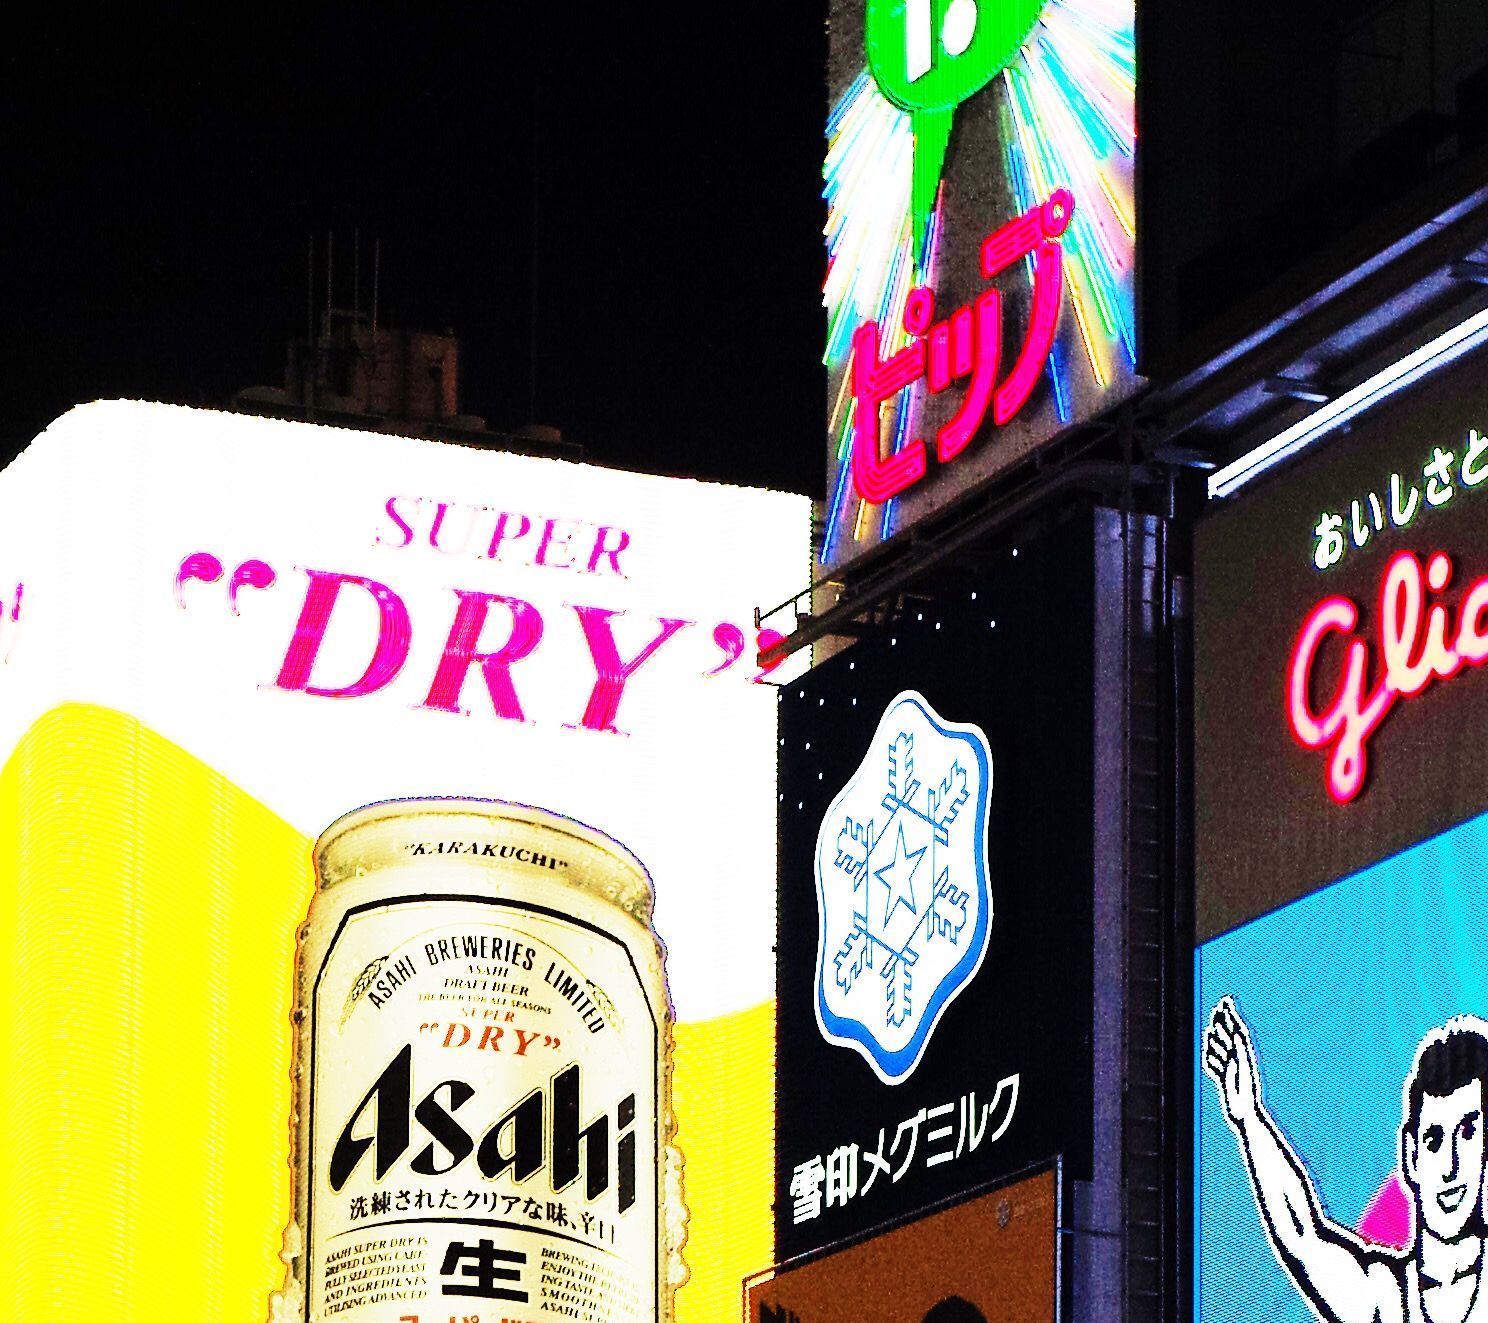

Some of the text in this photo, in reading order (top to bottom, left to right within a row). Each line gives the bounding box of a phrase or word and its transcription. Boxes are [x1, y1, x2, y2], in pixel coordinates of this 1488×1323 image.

[851, 188, 1074, 505] ピップ
[374, 494, 632, 579] SUPER
[368, 935, 606, 1035] ASAHI BREWERIES LIMITED
[328, 1042, 637, 1216] Asahi
[788, 1071, 1022, 1227] 雪印メグミルク
[439, 1238, 529, 1303] 生
